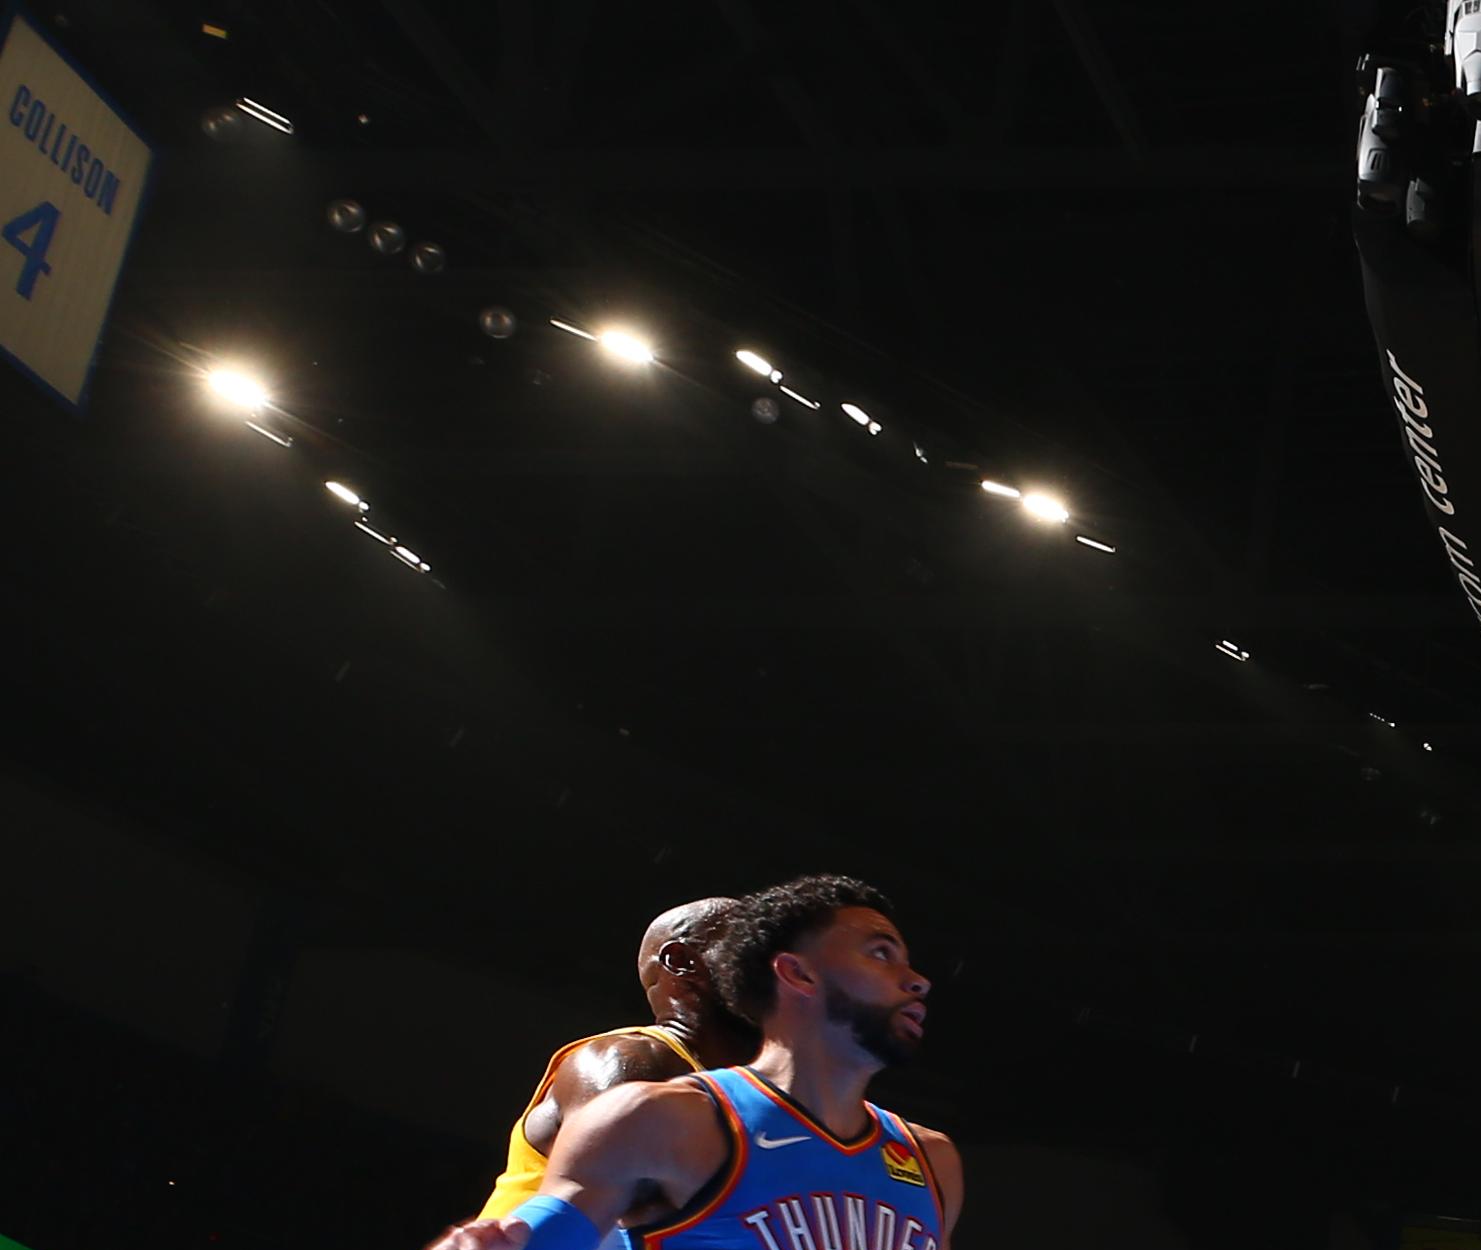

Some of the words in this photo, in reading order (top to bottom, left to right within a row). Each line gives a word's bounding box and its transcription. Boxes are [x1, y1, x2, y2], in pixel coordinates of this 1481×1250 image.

[8, 84, 121, 216] COLLISON
[1, 199, 63, 301] 4
[1386, 348, 1455, 517] center
